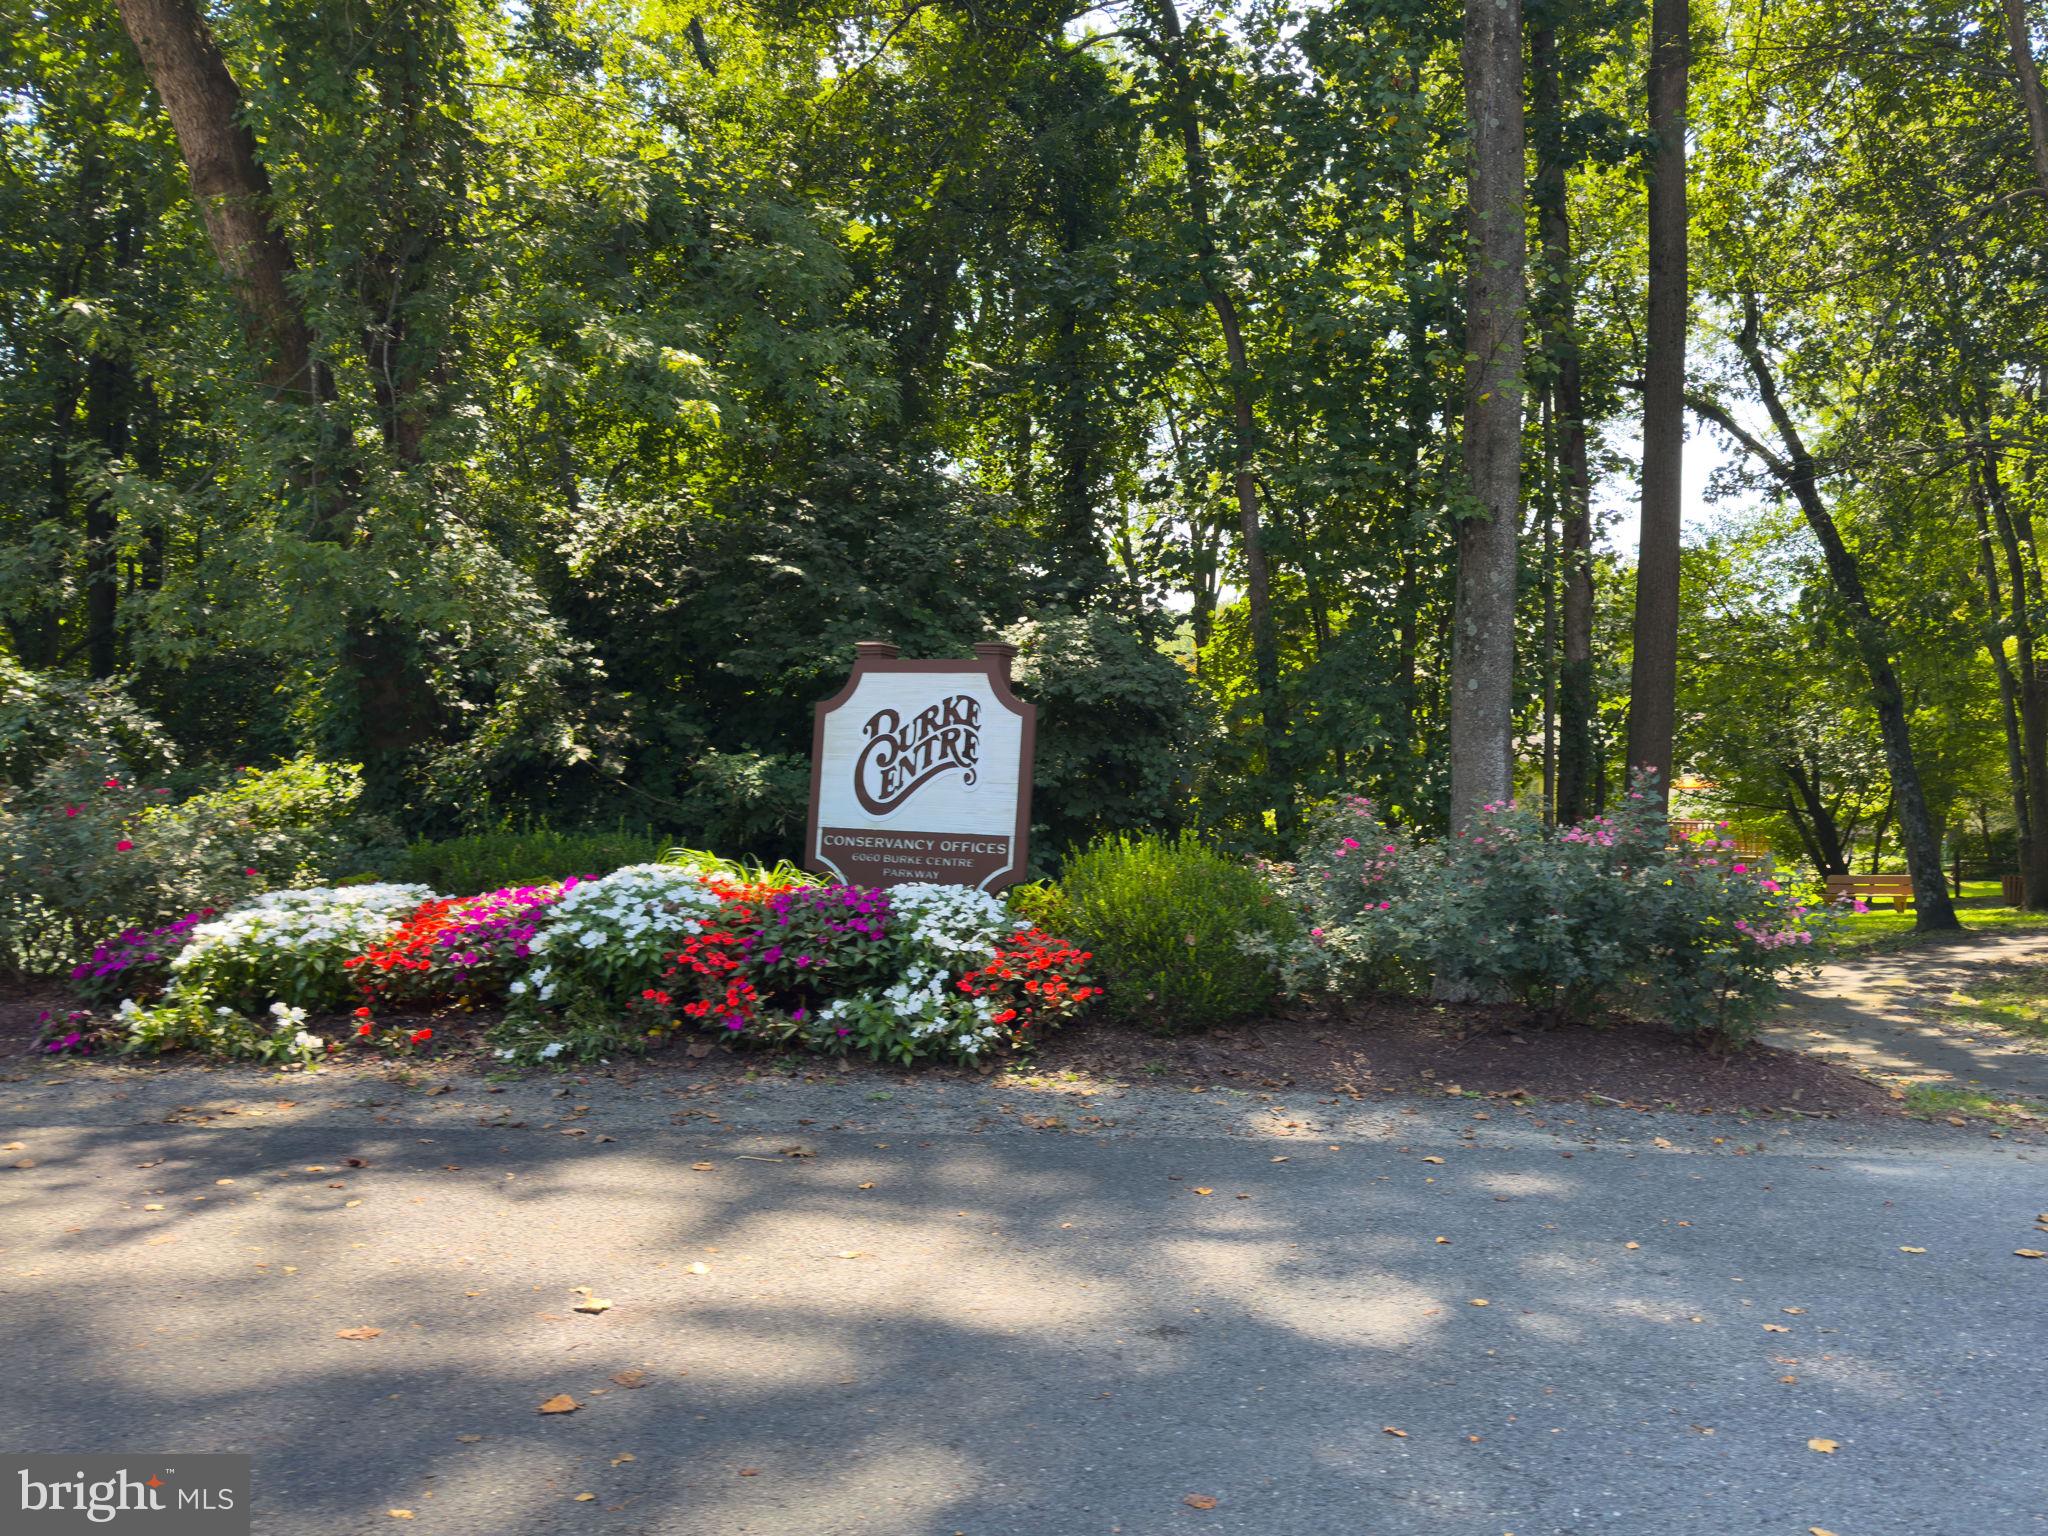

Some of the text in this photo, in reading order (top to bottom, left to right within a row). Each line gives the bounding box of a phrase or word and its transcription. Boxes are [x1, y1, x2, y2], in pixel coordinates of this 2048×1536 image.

[863, 695, 981, 752] BURKE
[854, 728, 979, 816] CENTRE
[823, 835, 1007, 854] CONSERVANCY OFFICES
[851, 853, 974, 868] 6060 BURKE CENTRE
[883, 868, 940, 880] PARKWAY
